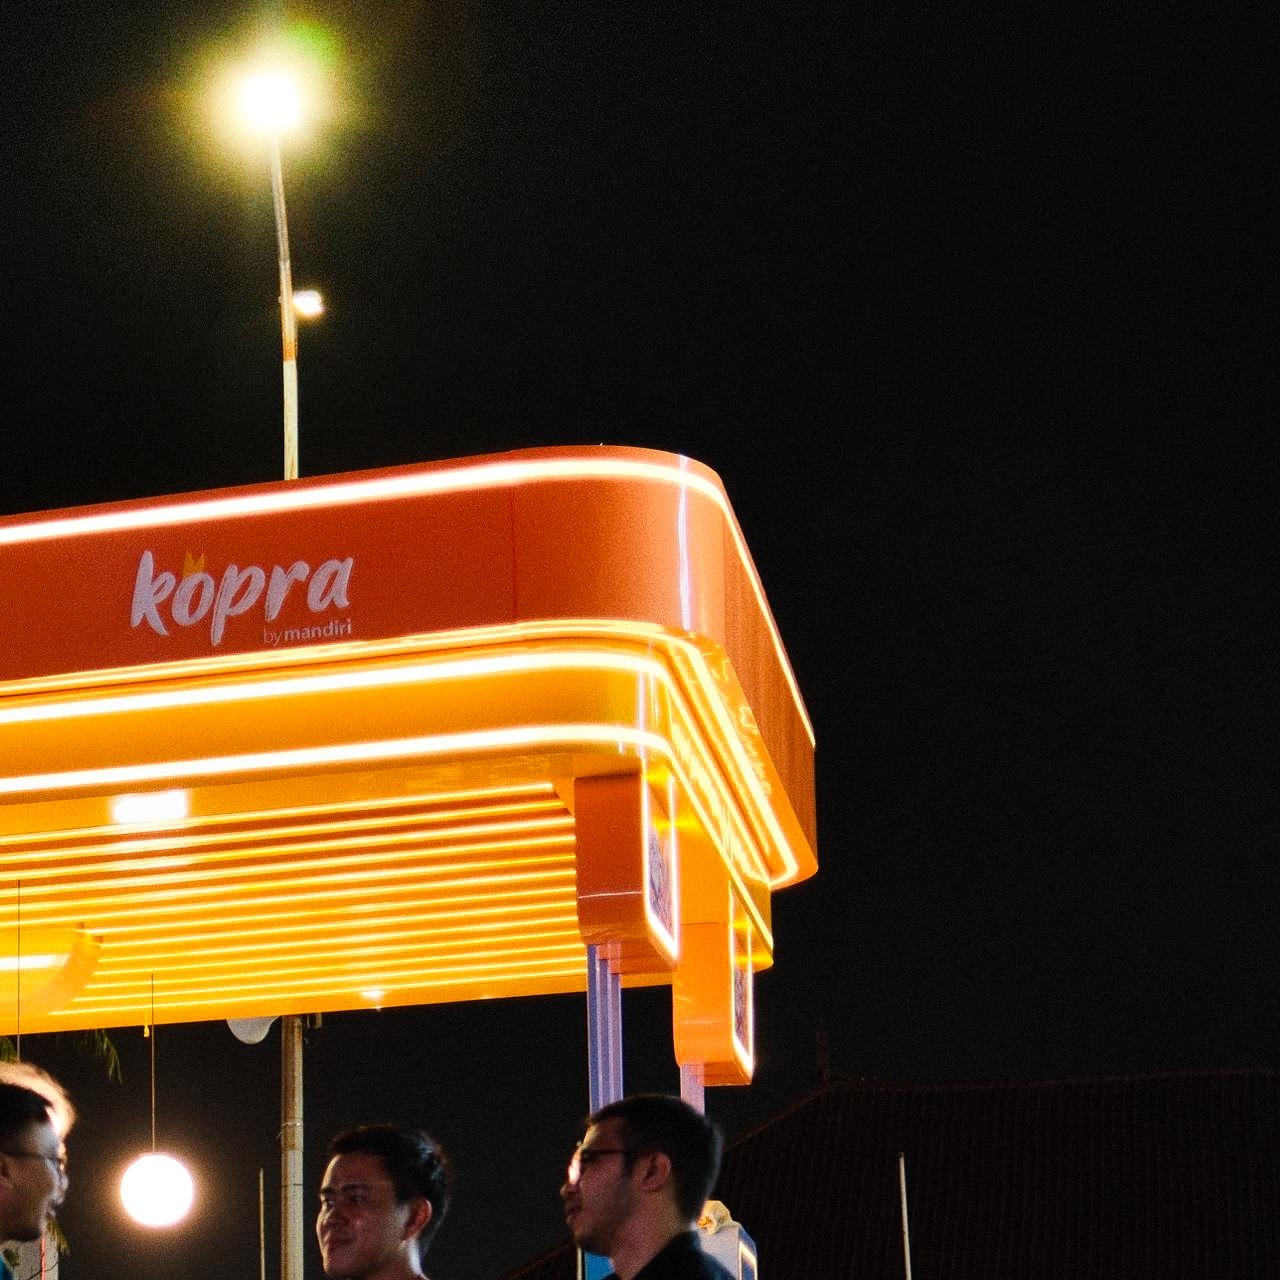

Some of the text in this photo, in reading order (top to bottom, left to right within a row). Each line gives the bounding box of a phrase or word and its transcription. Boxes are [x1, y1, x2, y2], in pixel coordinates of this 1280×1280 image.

[130, 550, 354, 647] kopra
[263, 619, 351, 646] by mandiri
